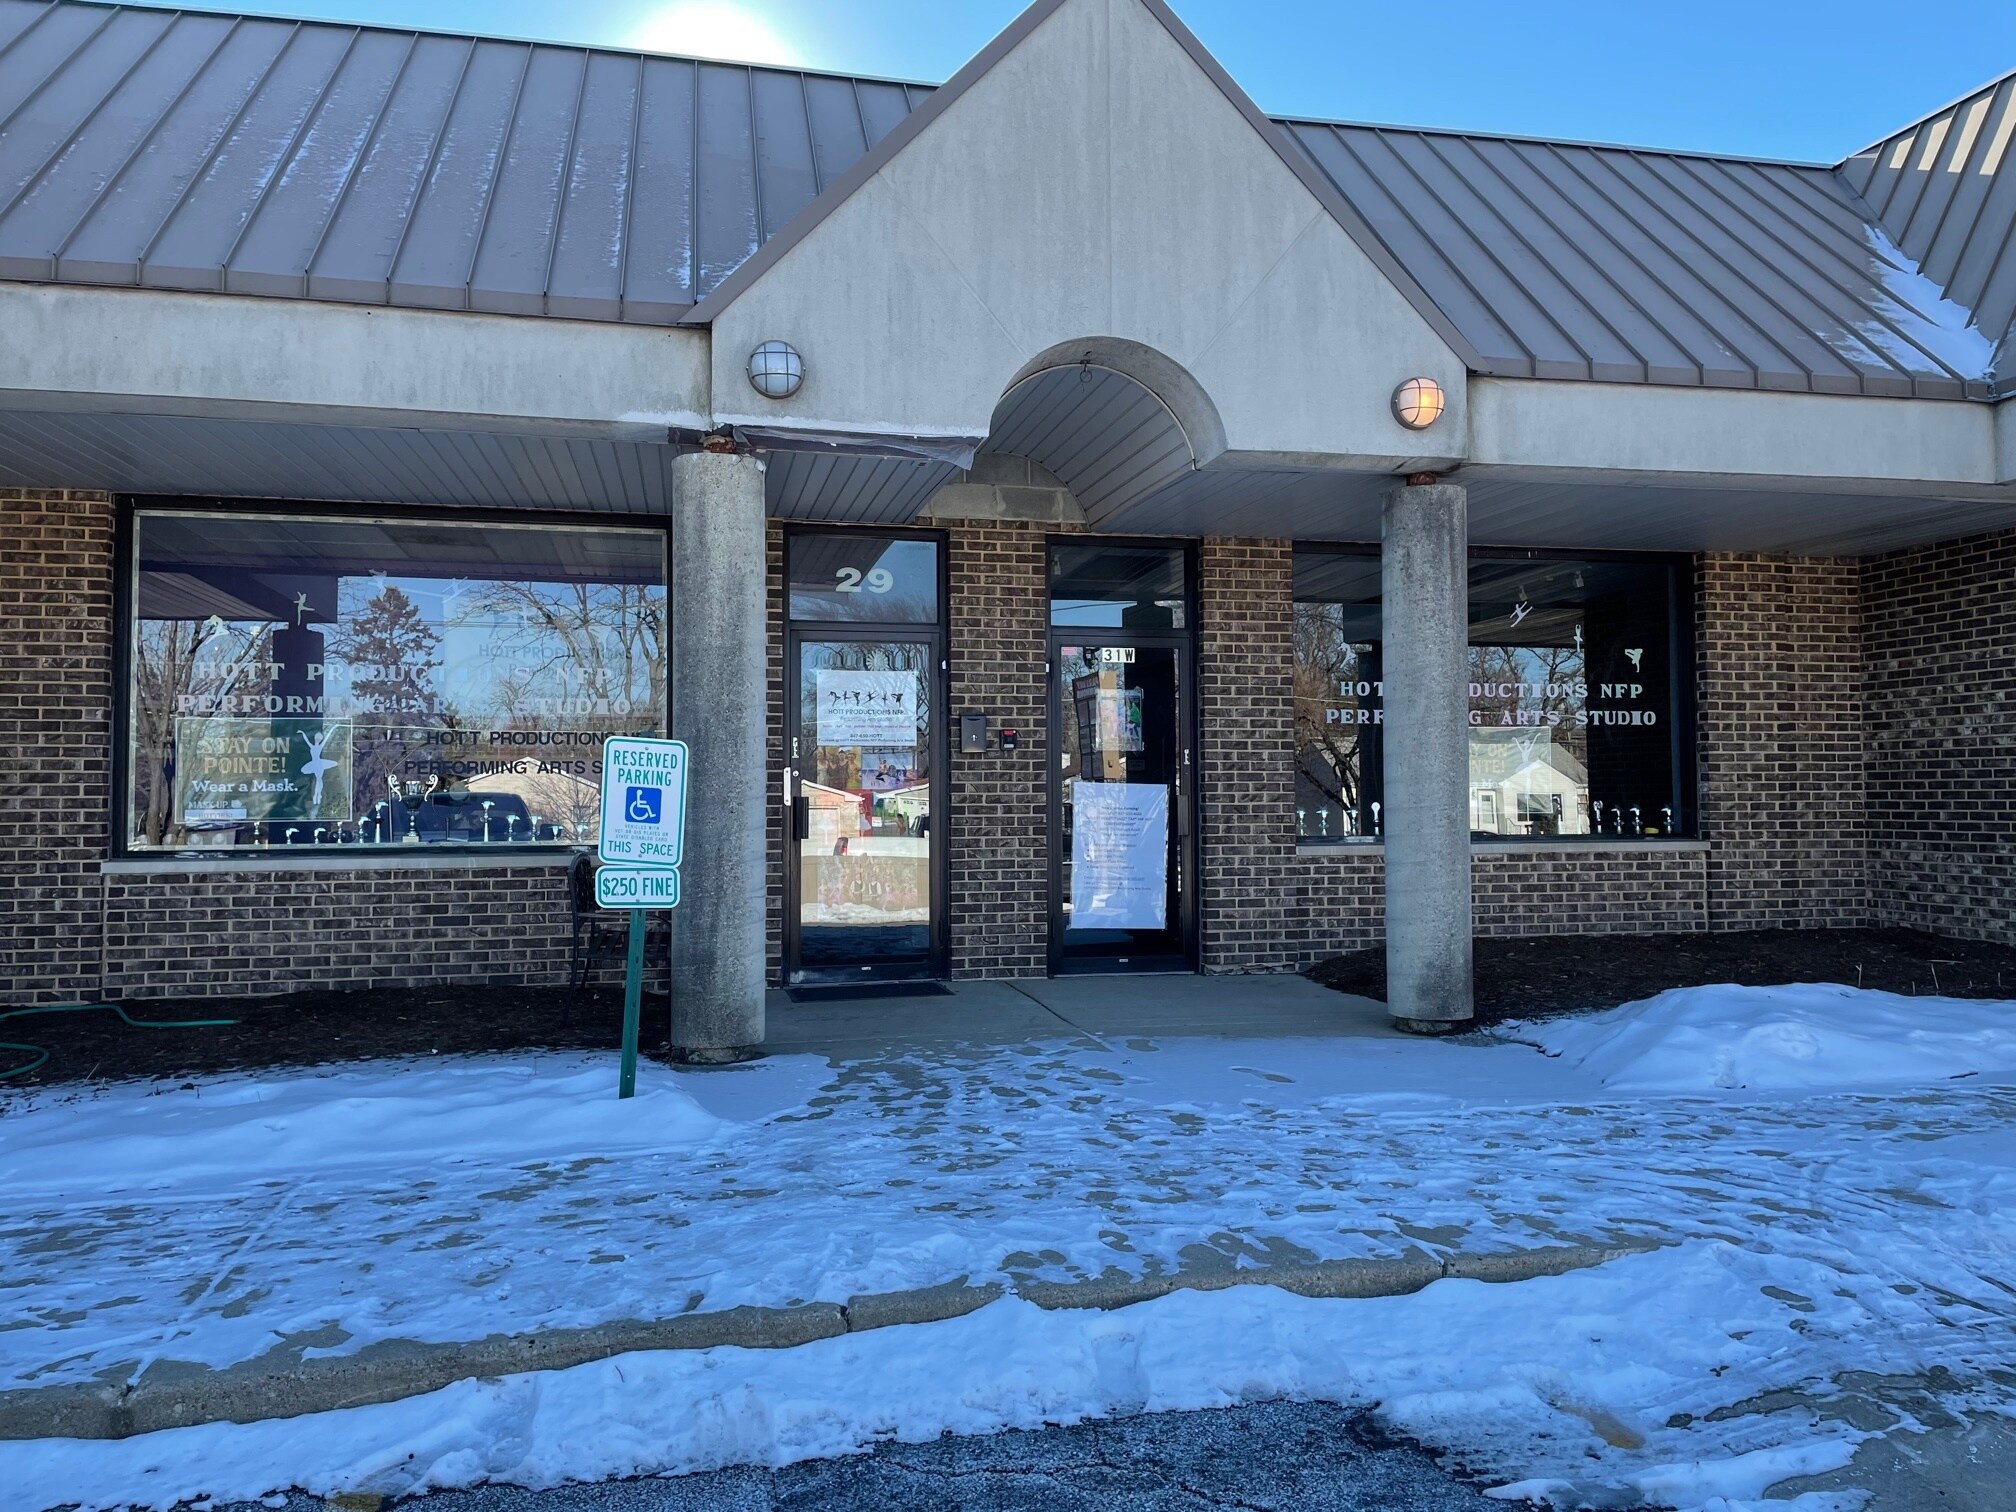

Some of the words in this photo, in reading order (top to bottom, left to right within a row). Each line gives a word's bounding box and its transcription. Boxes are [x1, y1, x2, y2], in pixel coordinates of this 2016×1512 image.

[836, 567, 894, 593] 29
[200, 663, 285, 681] HOTT
[556, 667, 613, 684] NFP
[1340, 681, 1384, 697] HOT
[1469, 682, 1588, 699] DUCTIONS
[1600, 683, 1644, 699] NFP
[176, 694, 386, 714] PERFORMING
[513, 697, 631, 715] STUDIO
[1501, 710, 1561, 726] ARTS
[1575, 710, 1657, 726] STUDIO
[197, 737, 251, 754] STAY
[261, 737, 290, 754] ON
[426, 731, 481, 745] HOTT
[203, 756, 287, 774] POINTE!
[404, 760, 528, 775] PERFORMING
[536, 760, 586, 775] ARTS
[613, 749, 678, 769] RESERVED
[192, 780, 234, 793] Wear
[238, 784, 248, 793] a
[251, 778, 299, 793] Mask.
[617, 768, 672, 787] PARKING
[608, 840, 632, 853] THIS
[639, 842, 674, 856] SPACE
[602, 876, 637, 897] $250
[642, 877, 673, 896] FINE
